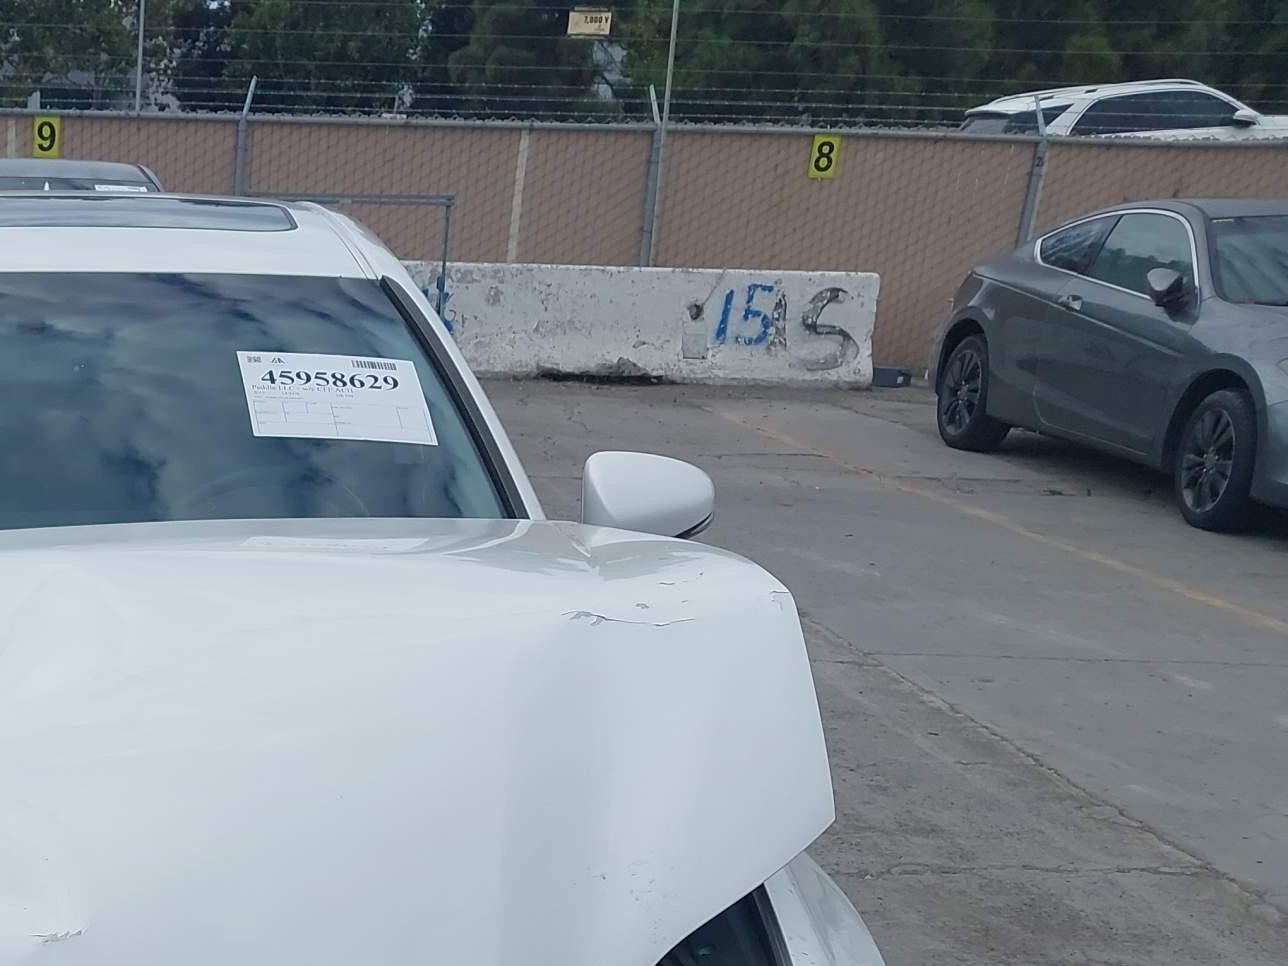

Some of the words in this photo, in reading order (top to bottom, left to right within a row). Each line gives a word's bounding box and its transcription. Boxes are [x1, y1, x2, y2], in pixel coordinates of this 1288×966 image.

[37, 121, 56, 152] 9
[814, 141, 835, 172] 8
[715, 283, 774, 345] 15
[261, 369, 399, 391] 45958629
